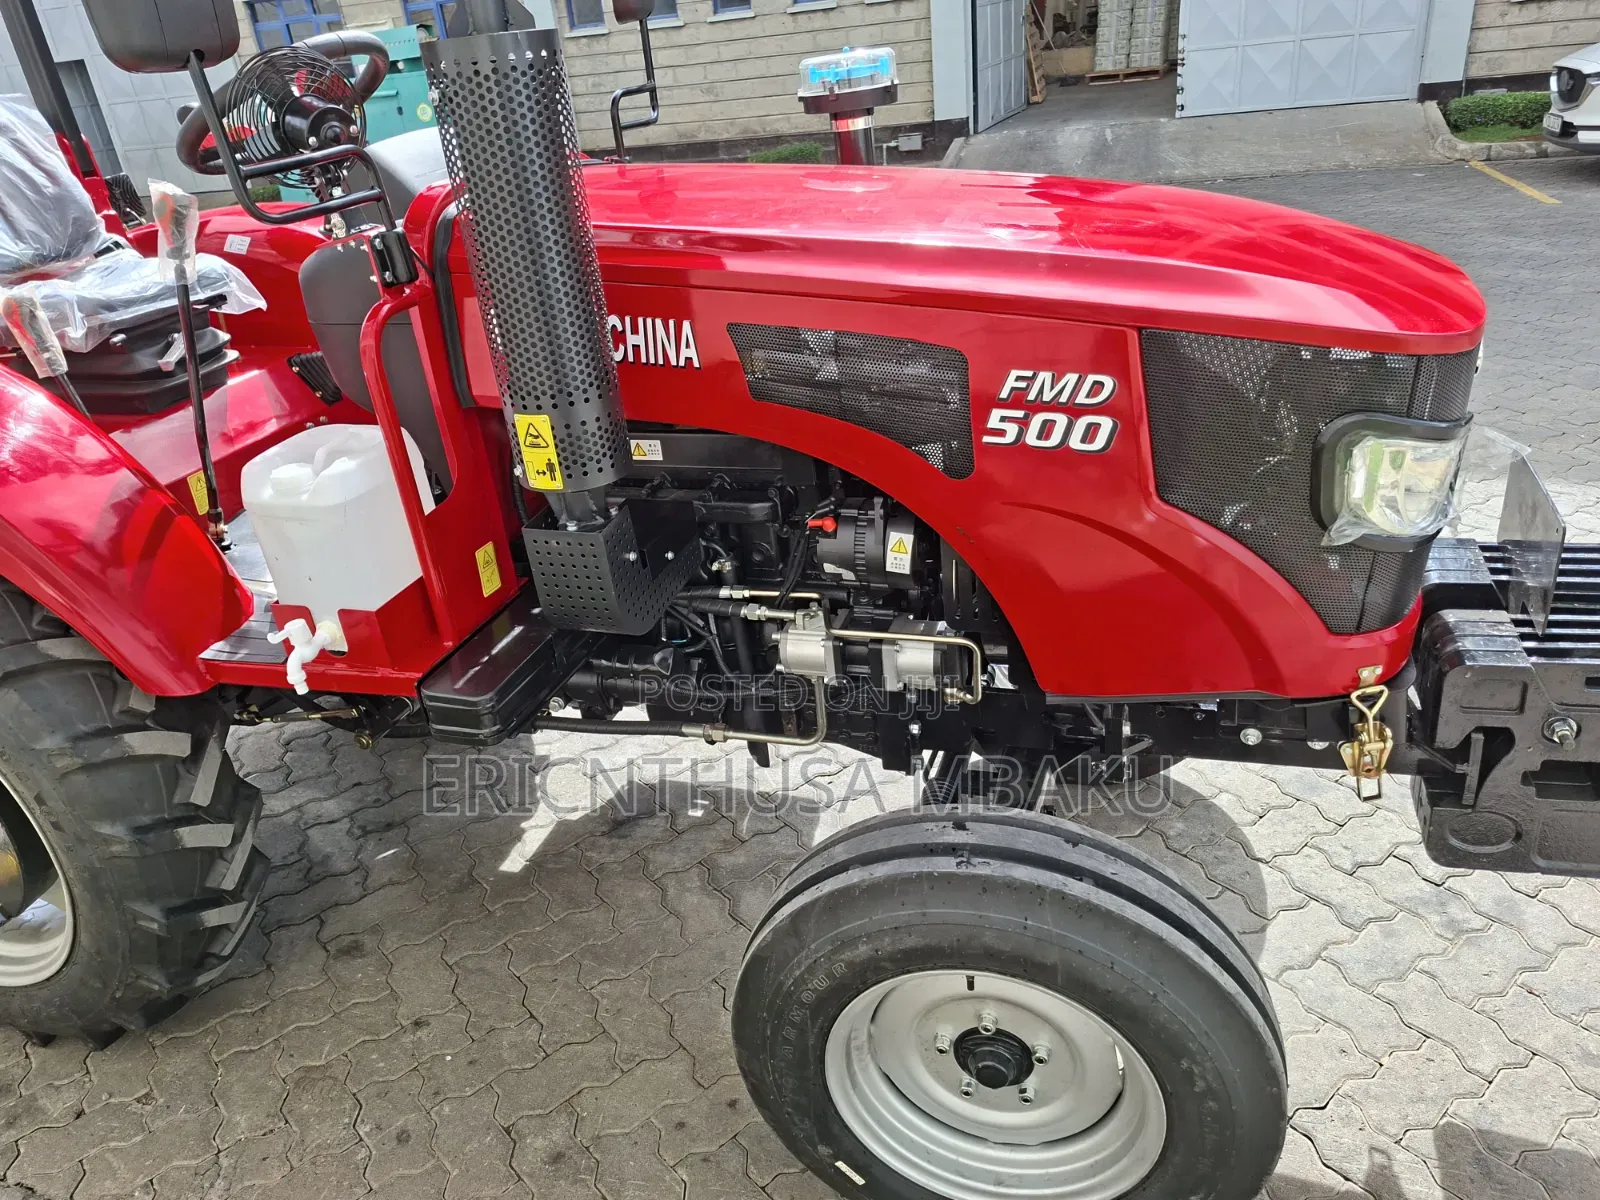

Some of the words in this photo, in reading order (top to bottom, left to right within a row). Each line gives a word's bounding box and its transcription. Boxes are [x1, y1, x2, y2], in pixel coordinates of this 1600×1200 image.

[606, 314, 701, 369] CHINA
[997, 369, 1117, 408] FMD
[981, 408, 1120, 454] 500
